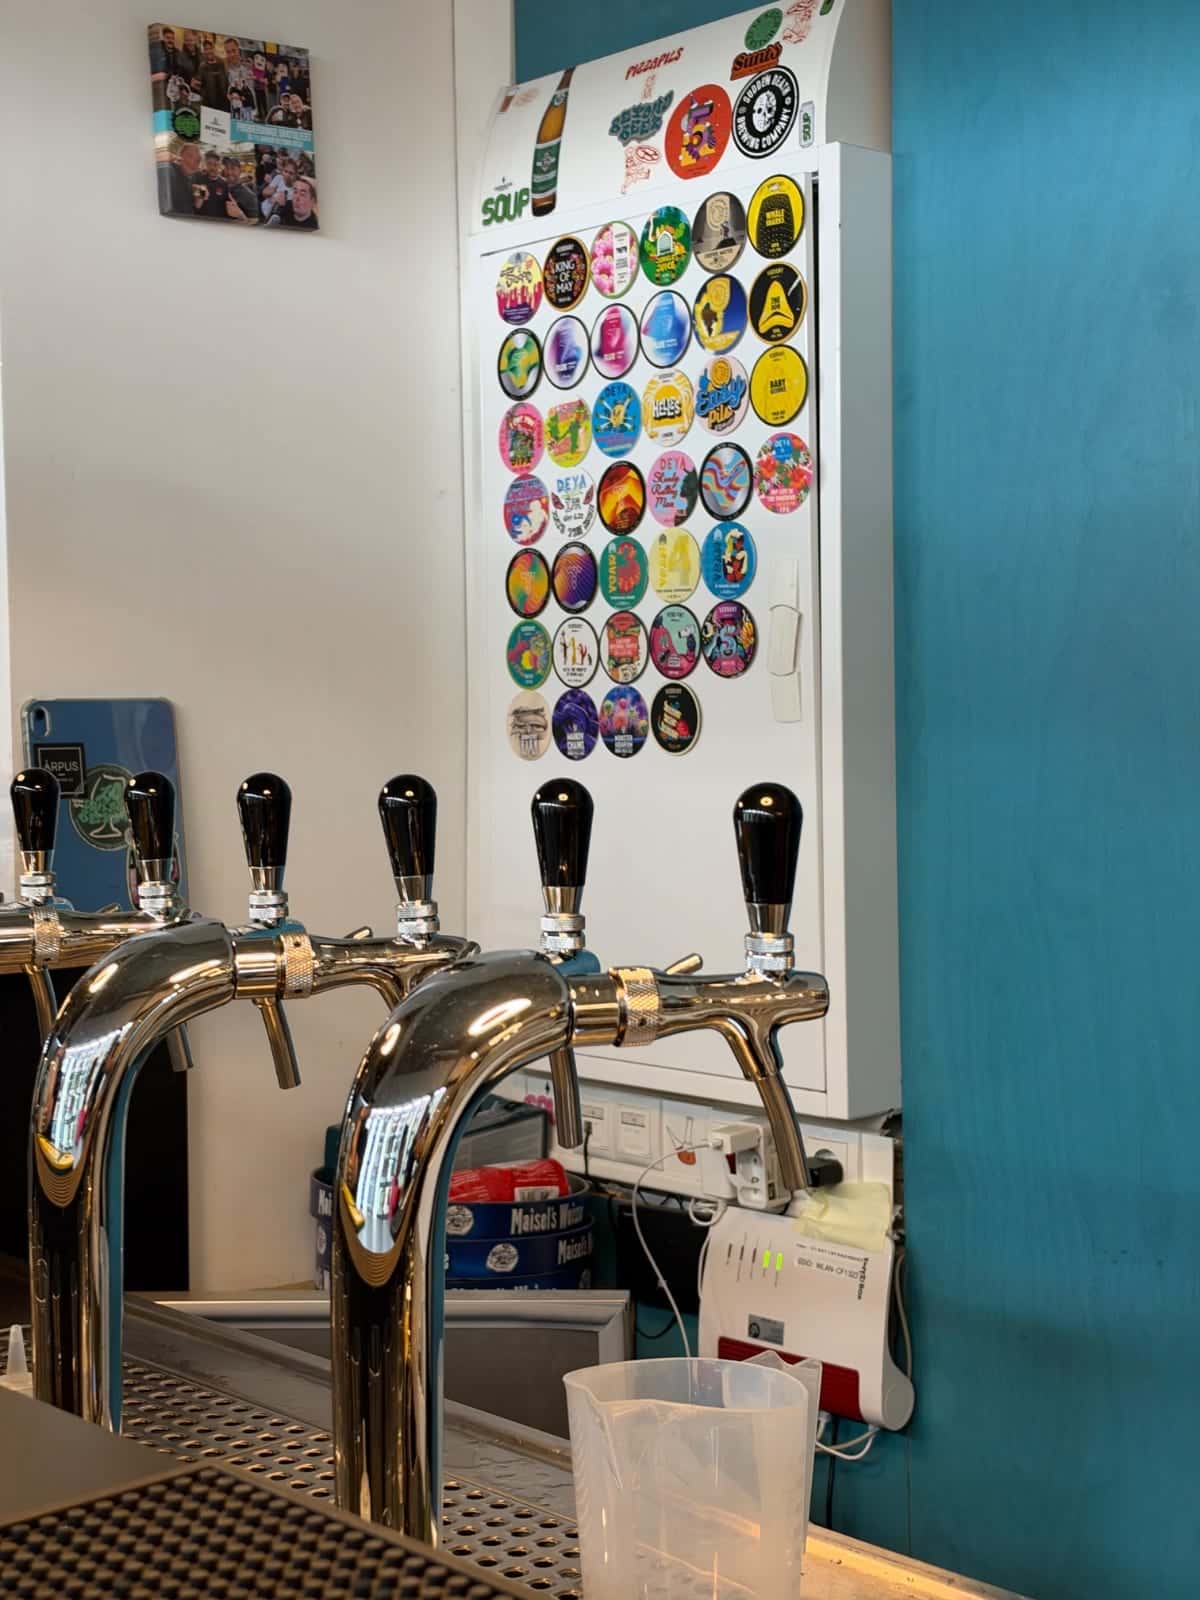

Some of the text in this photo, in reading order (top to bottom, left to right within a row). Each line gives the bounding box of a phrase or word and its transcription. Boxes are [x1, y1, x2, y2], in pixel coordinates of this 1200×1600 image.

[743, 74, 791, 104] SUDDEN DEATH
[737, 109, 792, 150] BREWING COMPANY
[802, 112, 812, 142] SOUP
[481, 187, 530, 226] SOUP
[553, 260, 576, 274] KING
[559, 273, 571, 283] OF
[556, 281, 574, 294] MAY
[556, 475, 587, 492] DEYA
[511, 1206, 558, 1235] Maisel's
